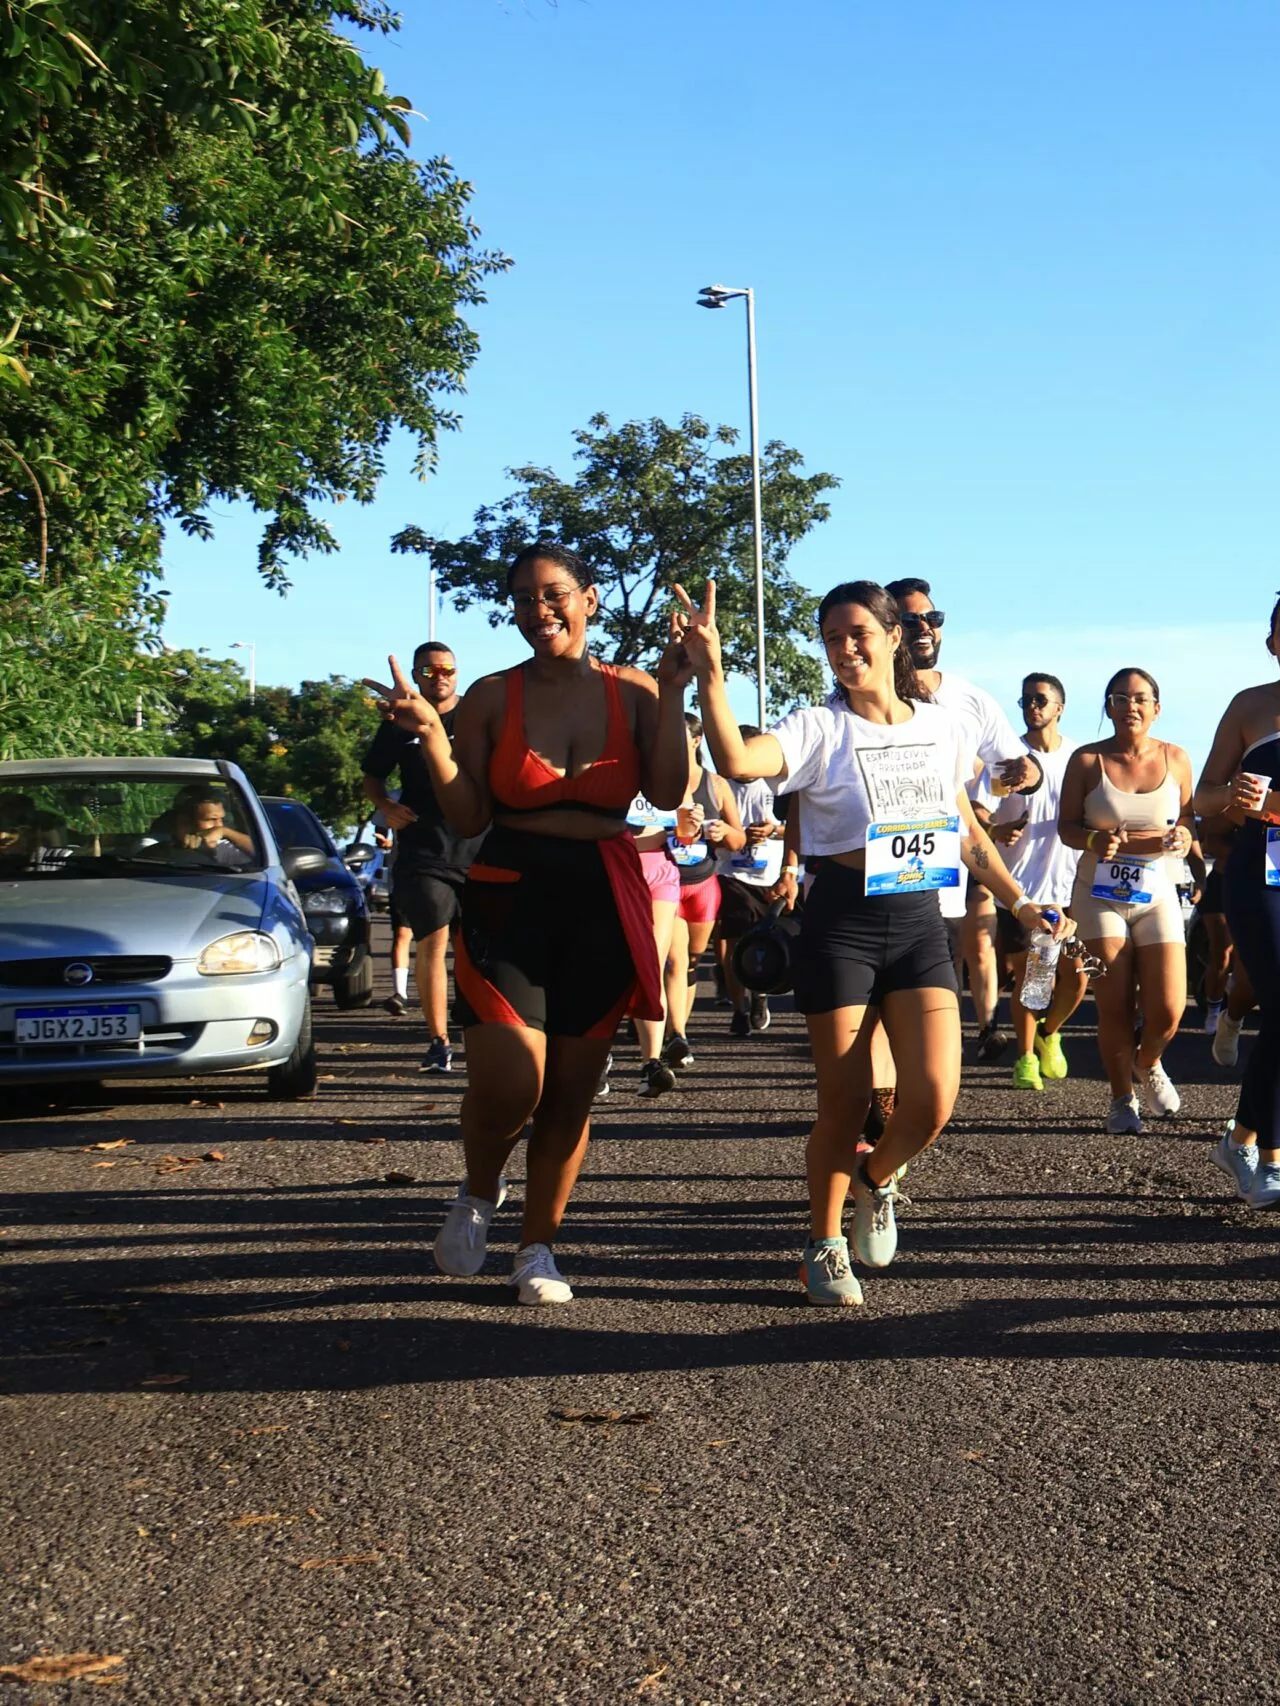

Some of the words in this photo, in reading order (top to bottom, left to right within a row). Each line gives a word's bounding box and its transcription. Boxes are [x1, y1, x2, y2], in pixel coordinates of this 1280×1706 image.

[891, 832, 935, 859] 045
[1110, 864, 1140, 883] 064
[27, 1016, 128, 1040] JGX2J53
